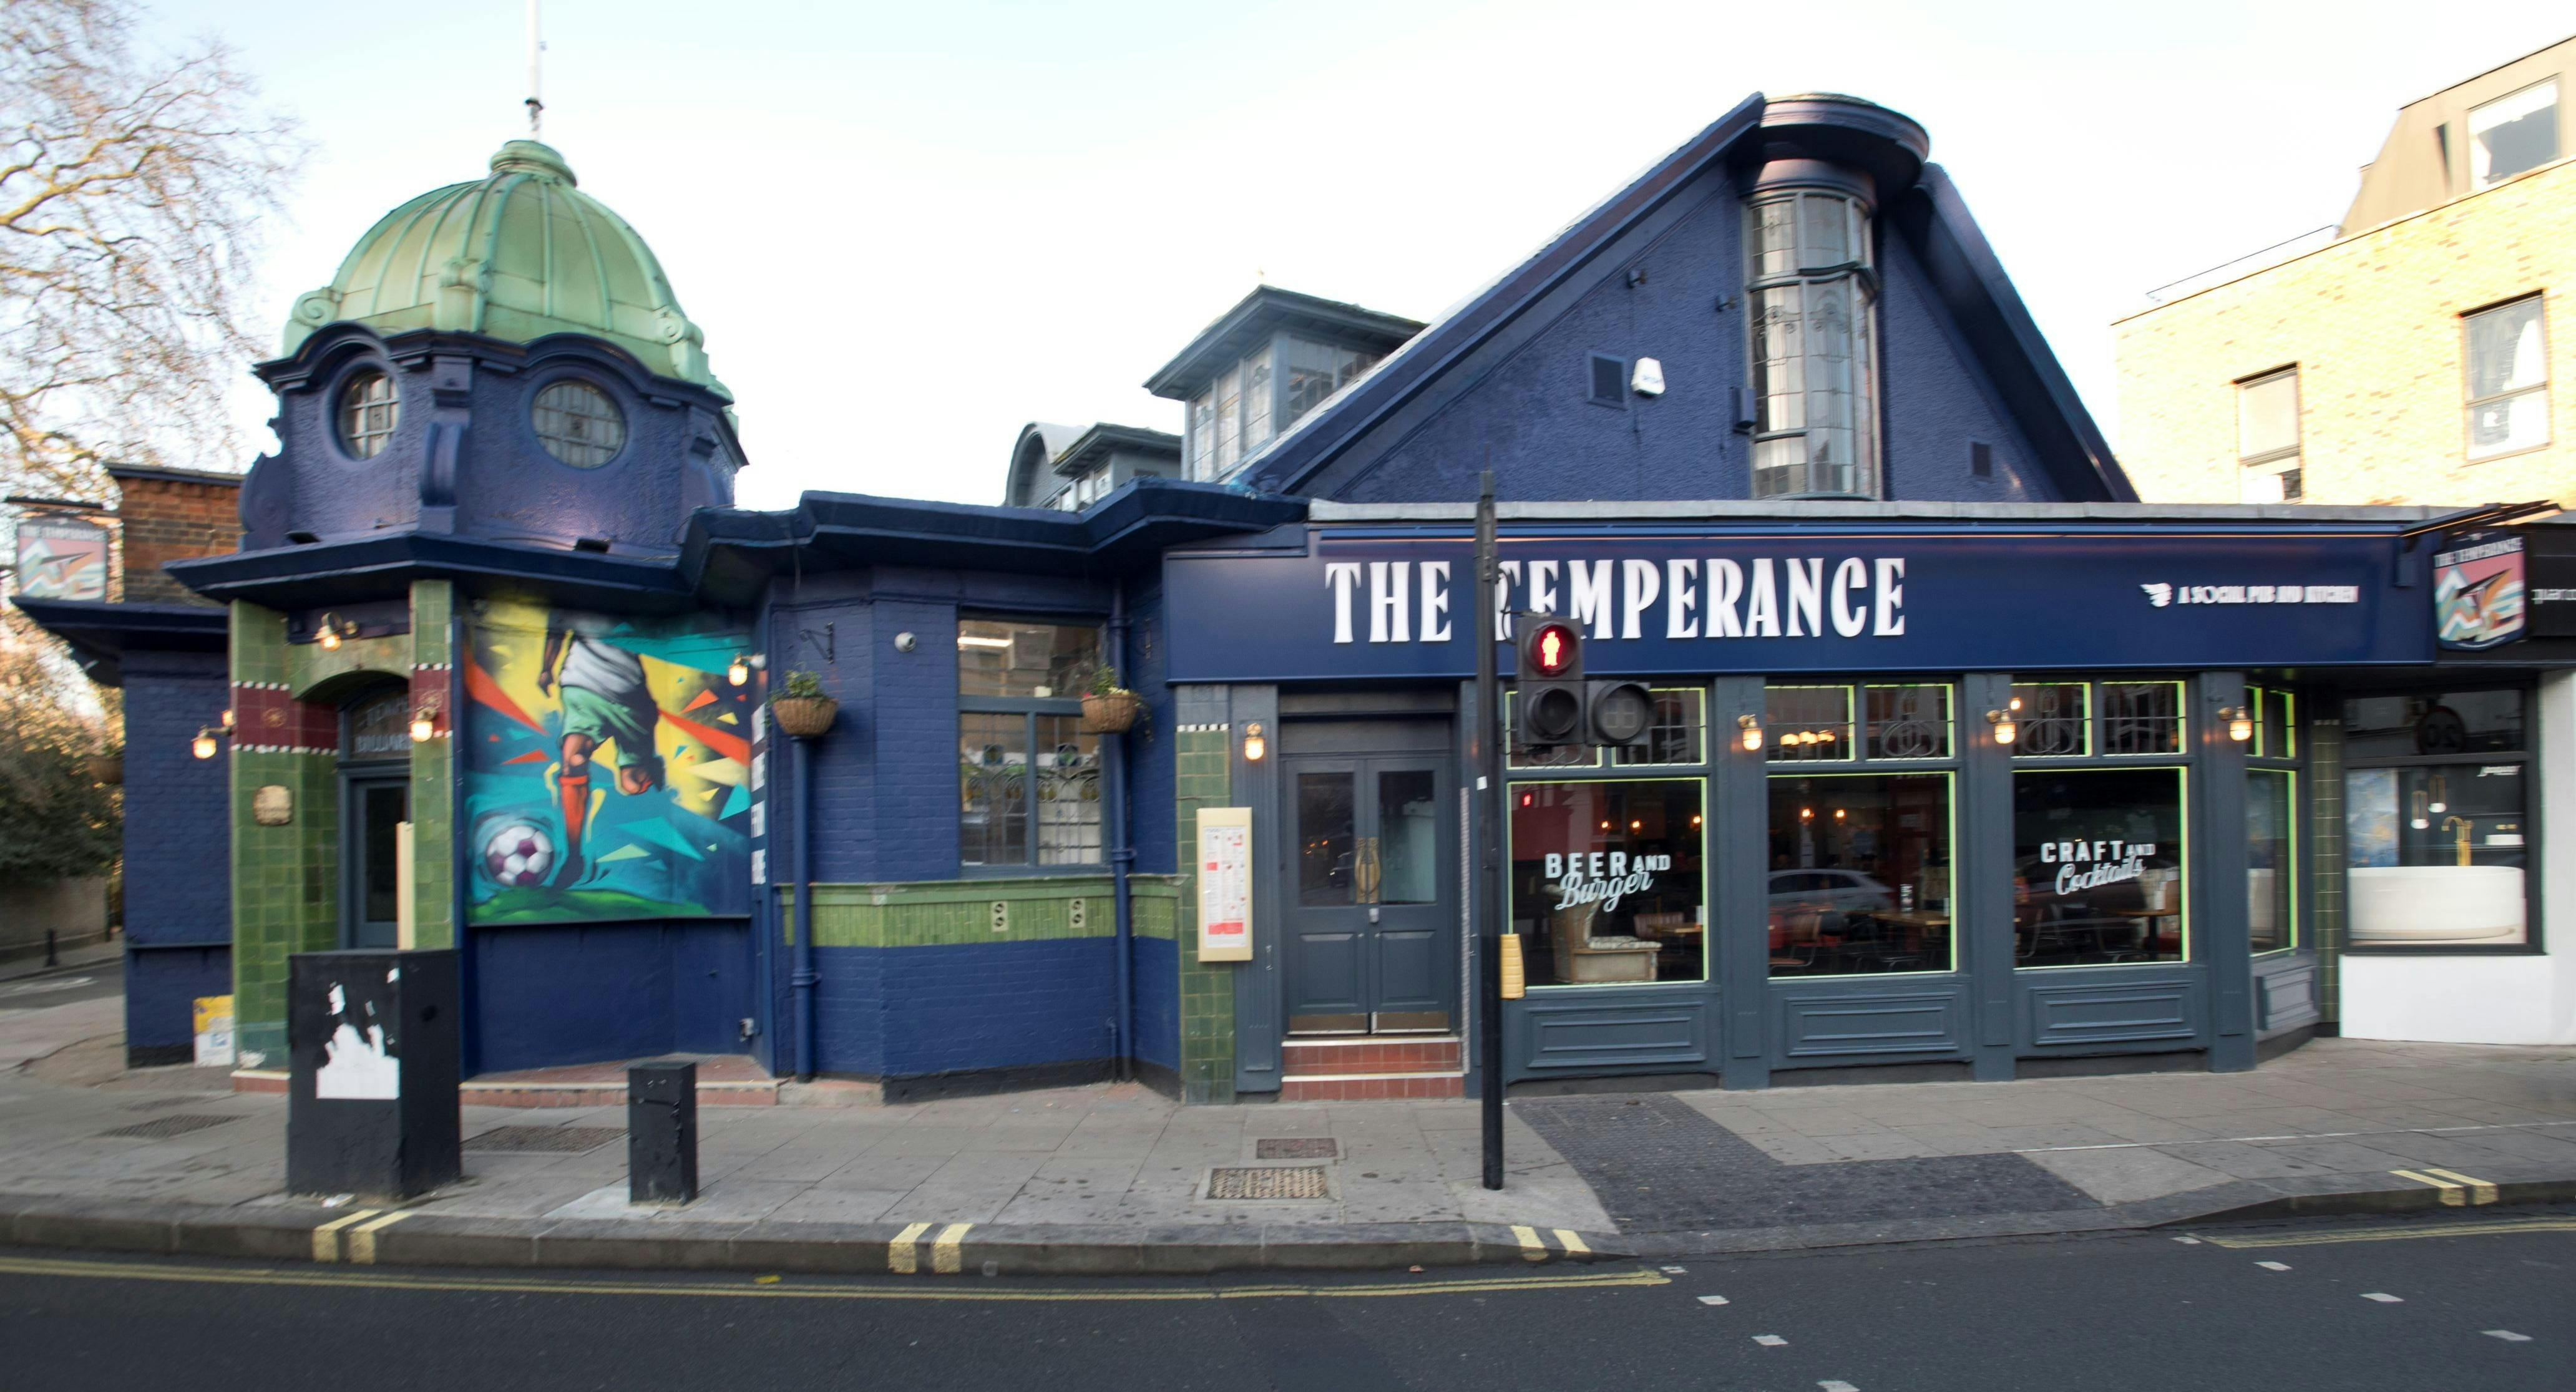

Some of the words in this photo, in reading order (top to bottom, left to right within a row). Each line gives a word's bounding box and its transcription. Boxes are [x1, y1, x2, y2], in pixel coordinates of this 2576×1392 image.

[1325, 561, 1452, 643] THE
[1494, 557, 1905, 640] TEMPERANCE
[2177, 586, 2190, 603] A
[1544, 851, 1627, 879] BEER
[1632, 854, 1671, 872] AND
[2041, 840, 2124, 863] CRAFT
[2125, 844, 2156, 857] AND
[1554, 870, 1654, 913] Burger
[2055, 855, 2147, 895] Cocktails
